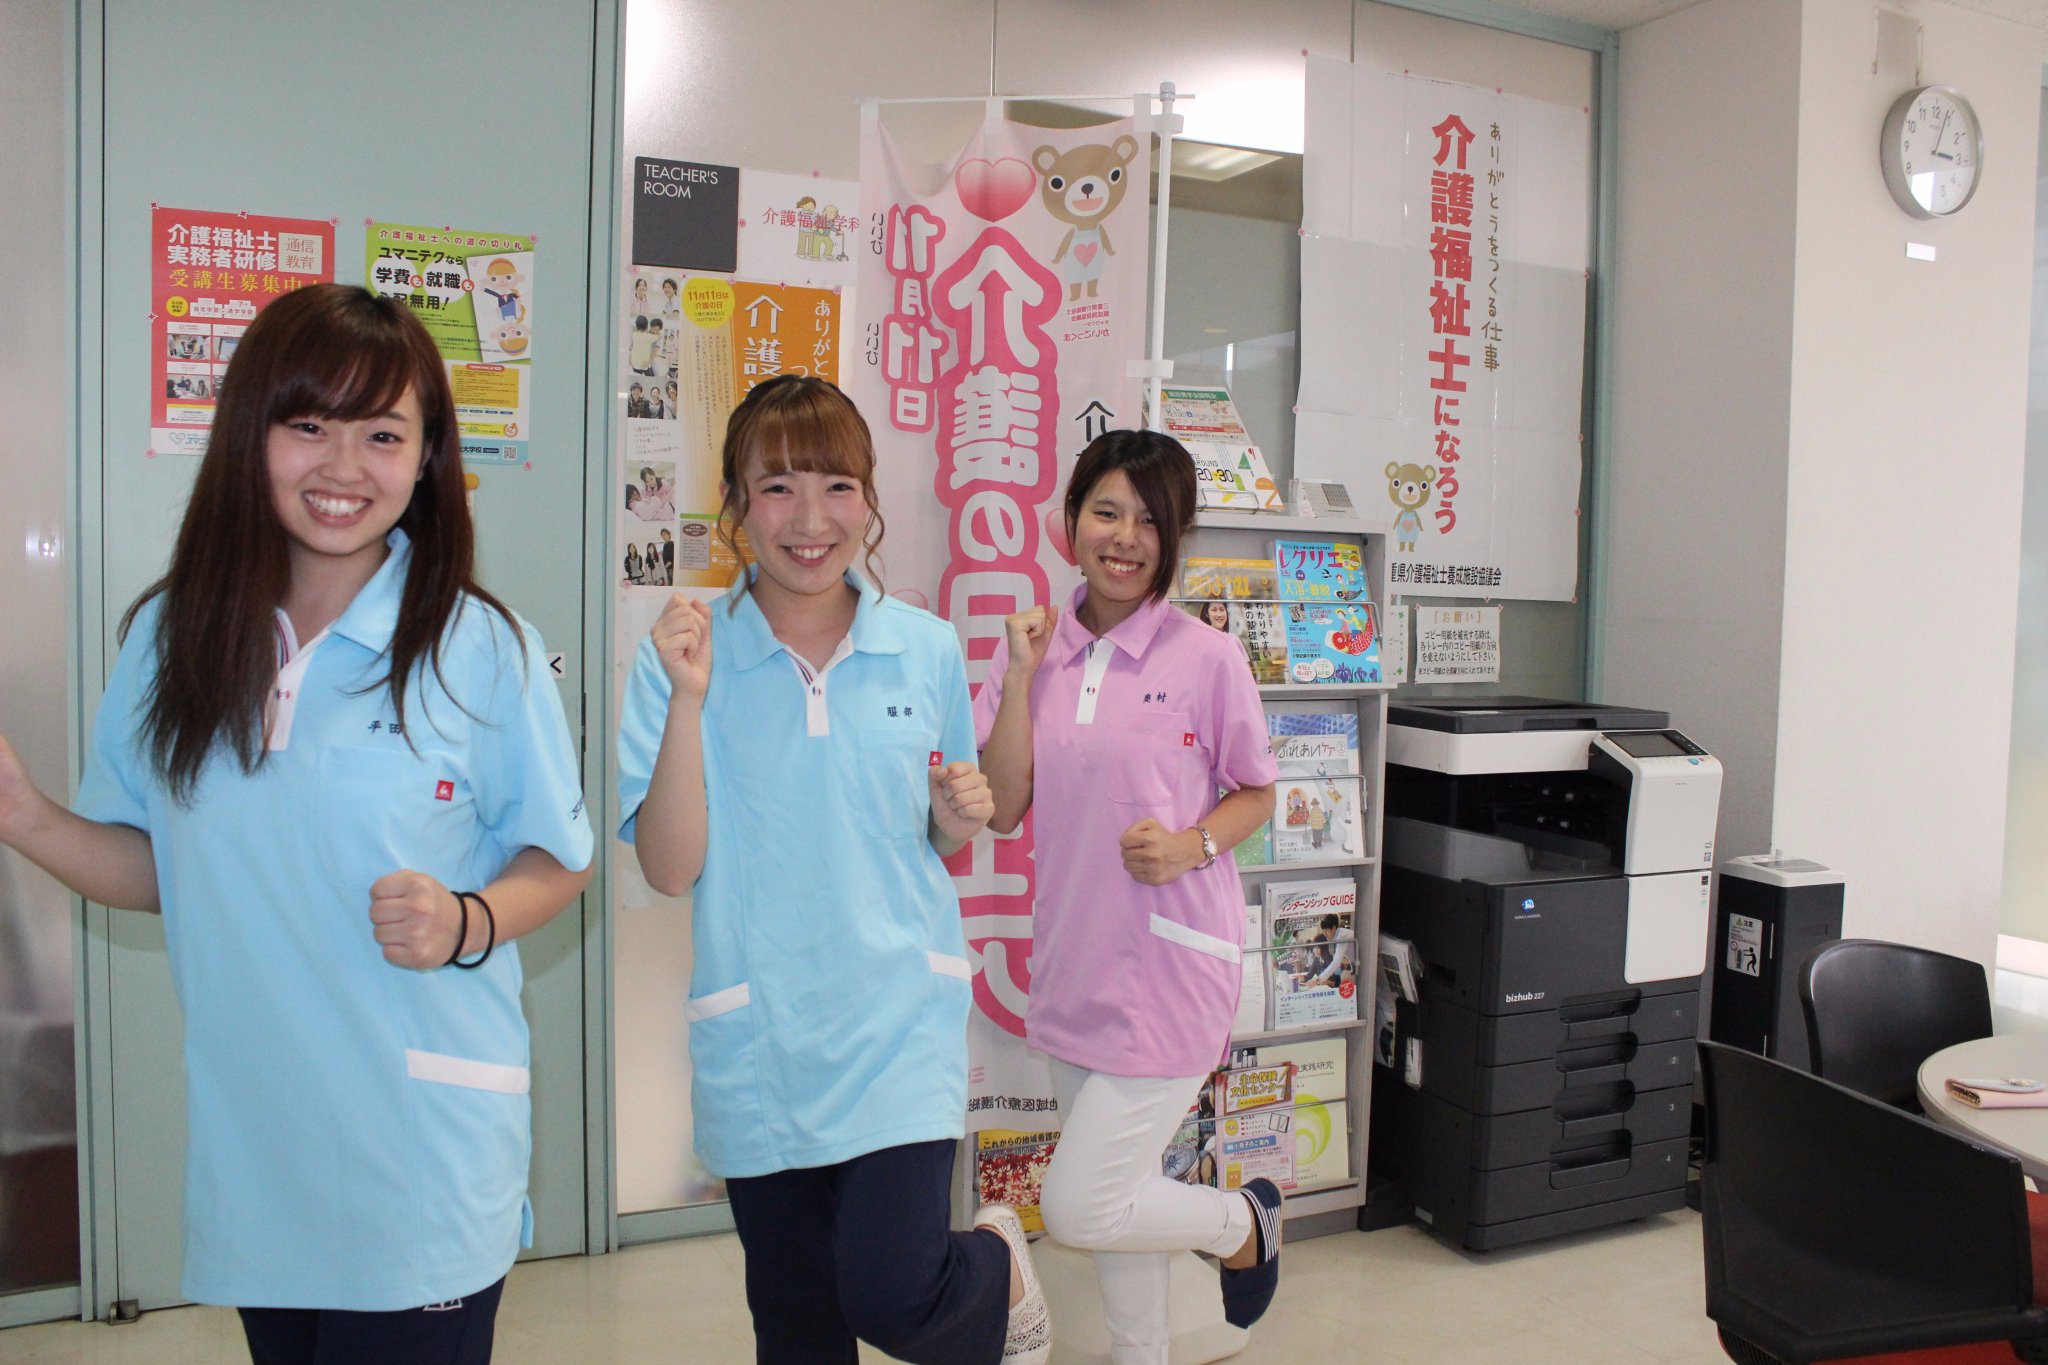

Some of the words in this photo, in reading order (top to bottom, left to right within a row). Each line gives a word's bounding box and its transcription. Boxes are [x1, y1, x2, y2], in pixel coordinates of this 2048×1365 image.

[643, 163, 719, 185] TEACHER'S
[643, 181, 693, 199] ROOM
[167, 223, 277, 251] 介護福祉士
[285, 237, 315, 254] 通信
[379, 229, 523, 250] 介護福祉士への道の切り札
[1480, 121, 1505, 372] ありがとうをつくる仕事
[167, 245, 277, 272] 実務者研修
[285, 254, 315, 271] 教育
[378, 246, 465, 266] ユマニテクなら
[1428, 113, 1477, 536] 介護福祉士になろう
[1278, 549, 1343, 570] レクリエ
[1505, 991, 1533, 1003] bizhub
[1533, 992, 1545, 1000] 227
